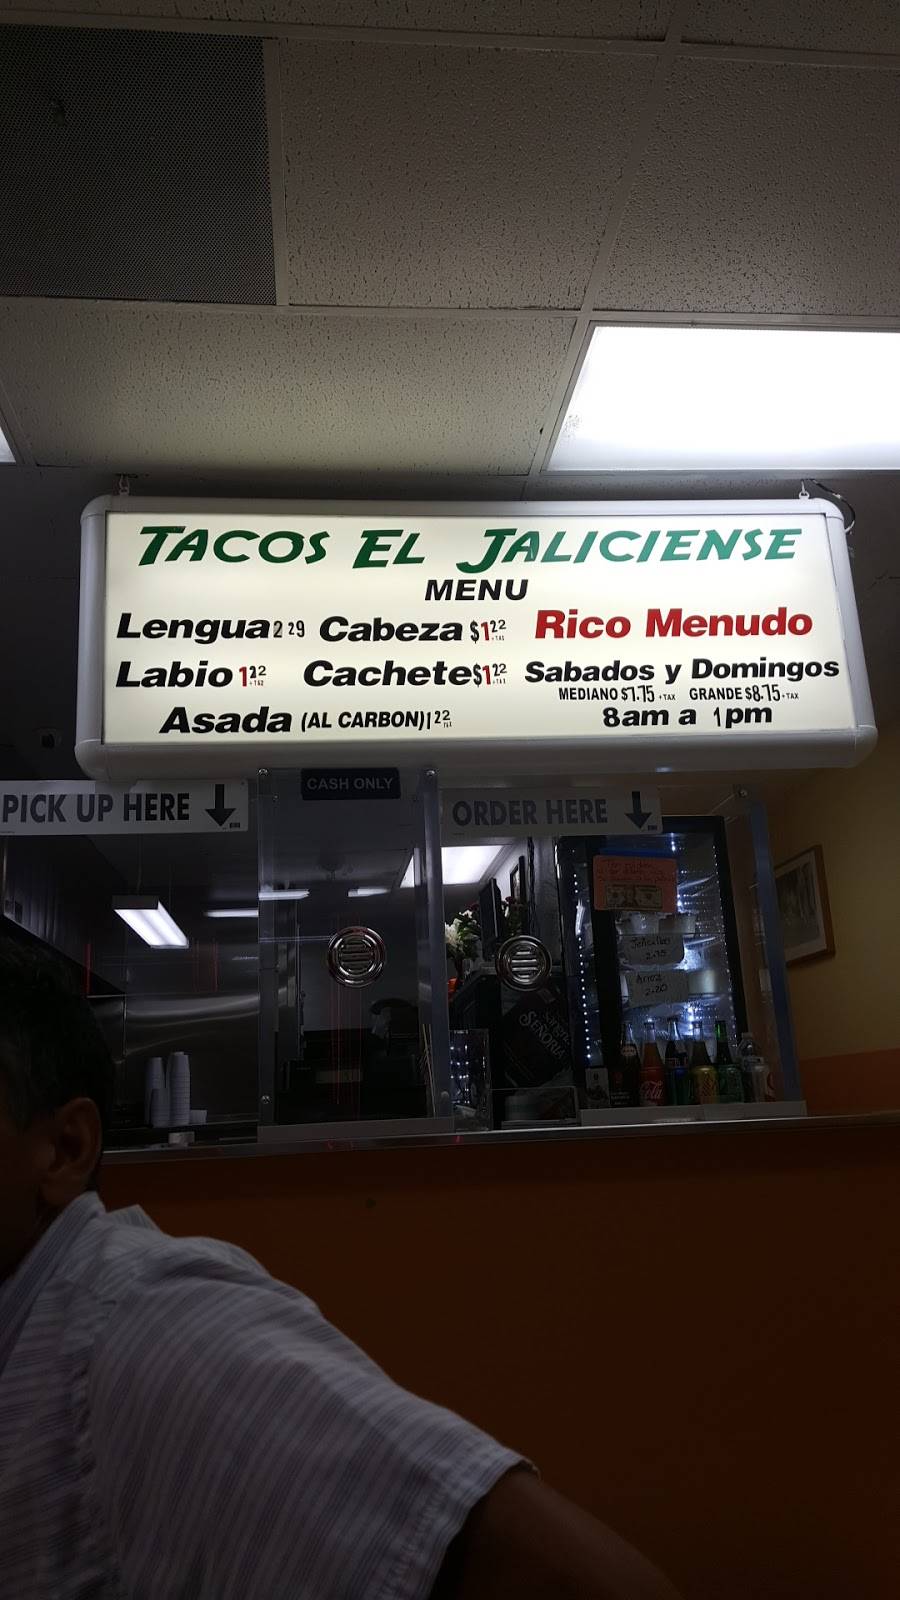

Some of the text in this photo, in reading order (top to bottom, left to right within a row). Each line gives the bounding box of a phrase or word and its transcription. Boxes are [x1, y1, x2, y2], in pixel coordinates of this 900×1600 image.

[138, 525, 802, 574] TACOS EL JALICIENSE
[424, 579, 529, 601] MENU
[116, 612, 271, 645] Lengua
[319, 615, 463, 642] Cabeza
[535, 606, 813, 639] Rico Menudo
[115, 660, 233, 688] Labio
[303, 660, 472, 687] Cachete
[524, 656, 840, 685] Sabados y Domingos
[558, 687, 618, 701] MEDIANO
[621, 685, 655, 703] $7.75
[689, 687, 742, 701] GRANDE
[745, 684, 781, 702] $8.75
[158, 706, 292, 734] Asada
[301, 711, 332, 733] (AL
[338, 711, 424, 731] CARBON)
[602, 706, 773, 729] 8am a 1pm
[306, 777, 393, 790] CASH ONLY
[2, 792, 190, 823] PICK UP HERE
[452, 798, 608, 826] ORDER HERE
